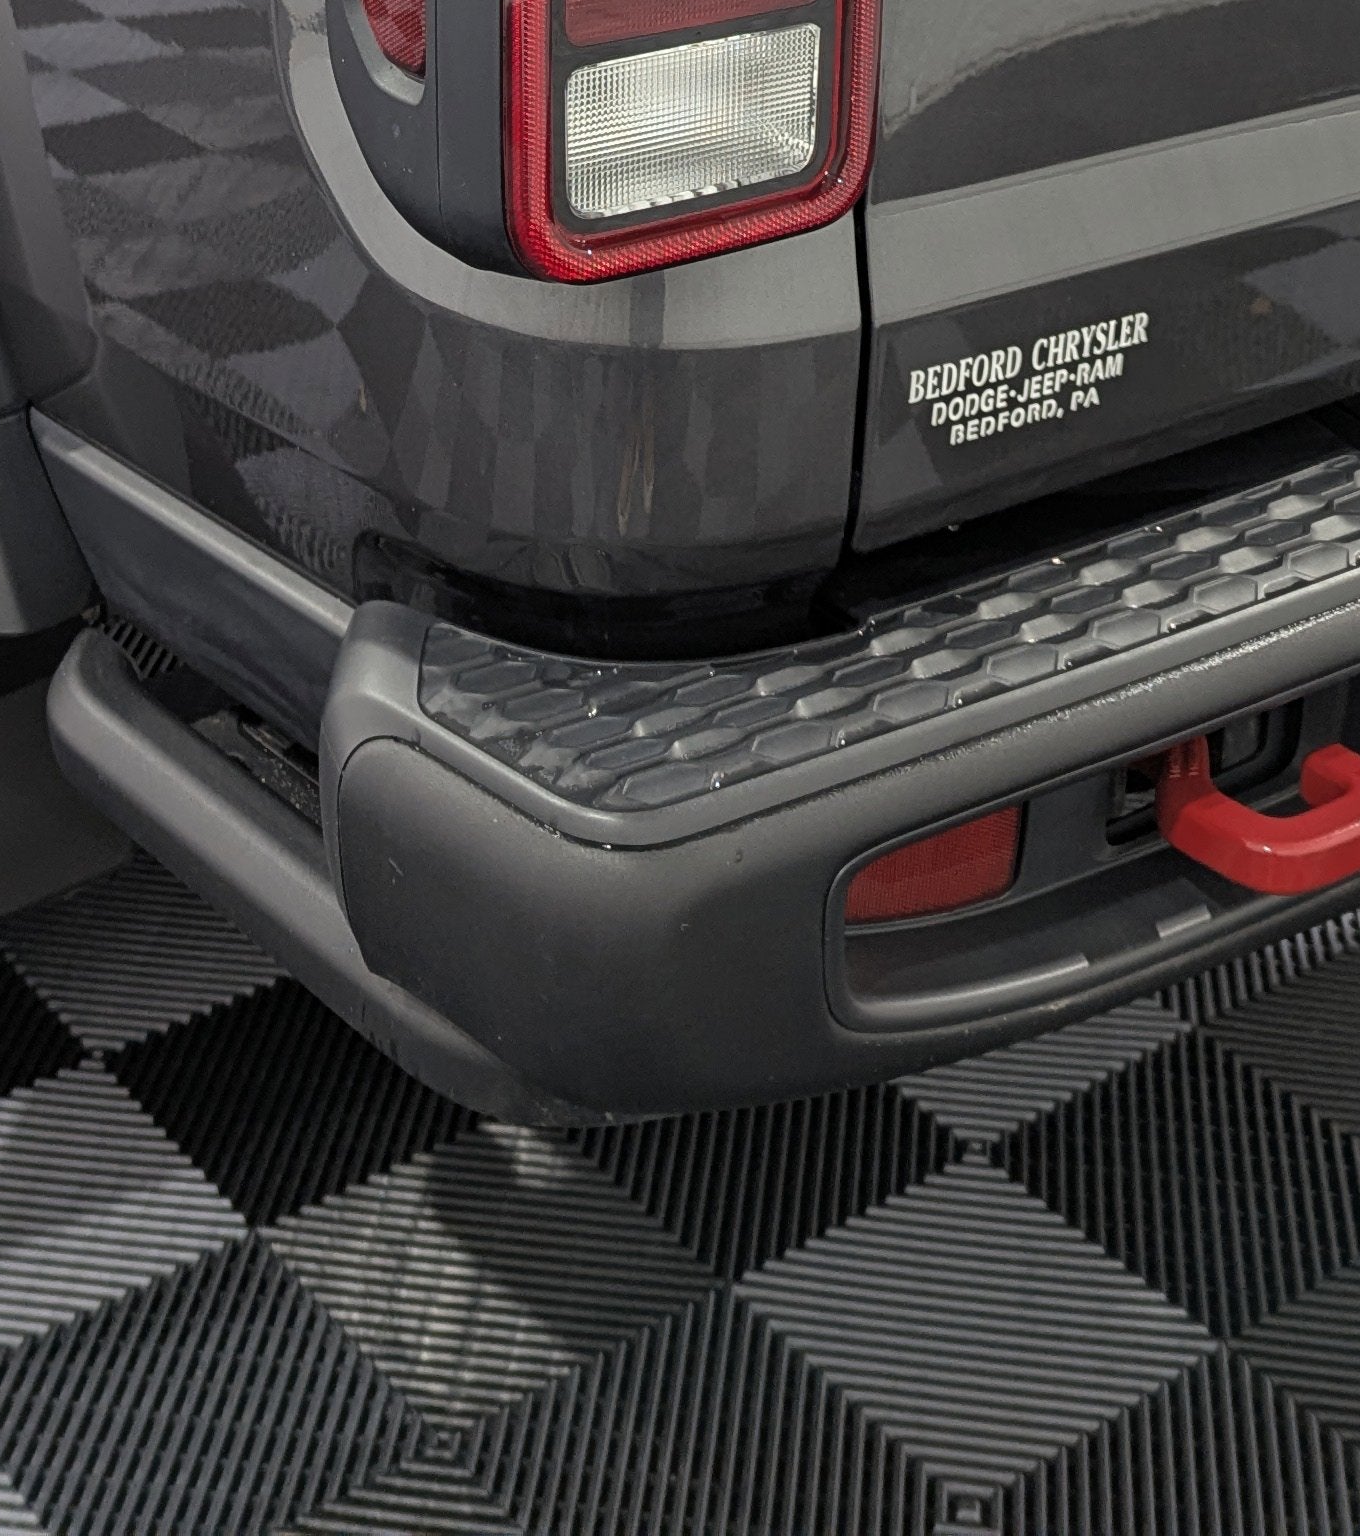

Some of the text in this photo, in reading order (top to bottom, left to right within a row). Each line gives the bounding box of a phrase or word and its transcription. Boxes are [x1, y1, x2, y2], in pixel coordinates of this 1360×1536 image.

[908, 312, 1150, 404] BEDFORD CHRYSLER
[1070, 386, 1101, 412] PA
